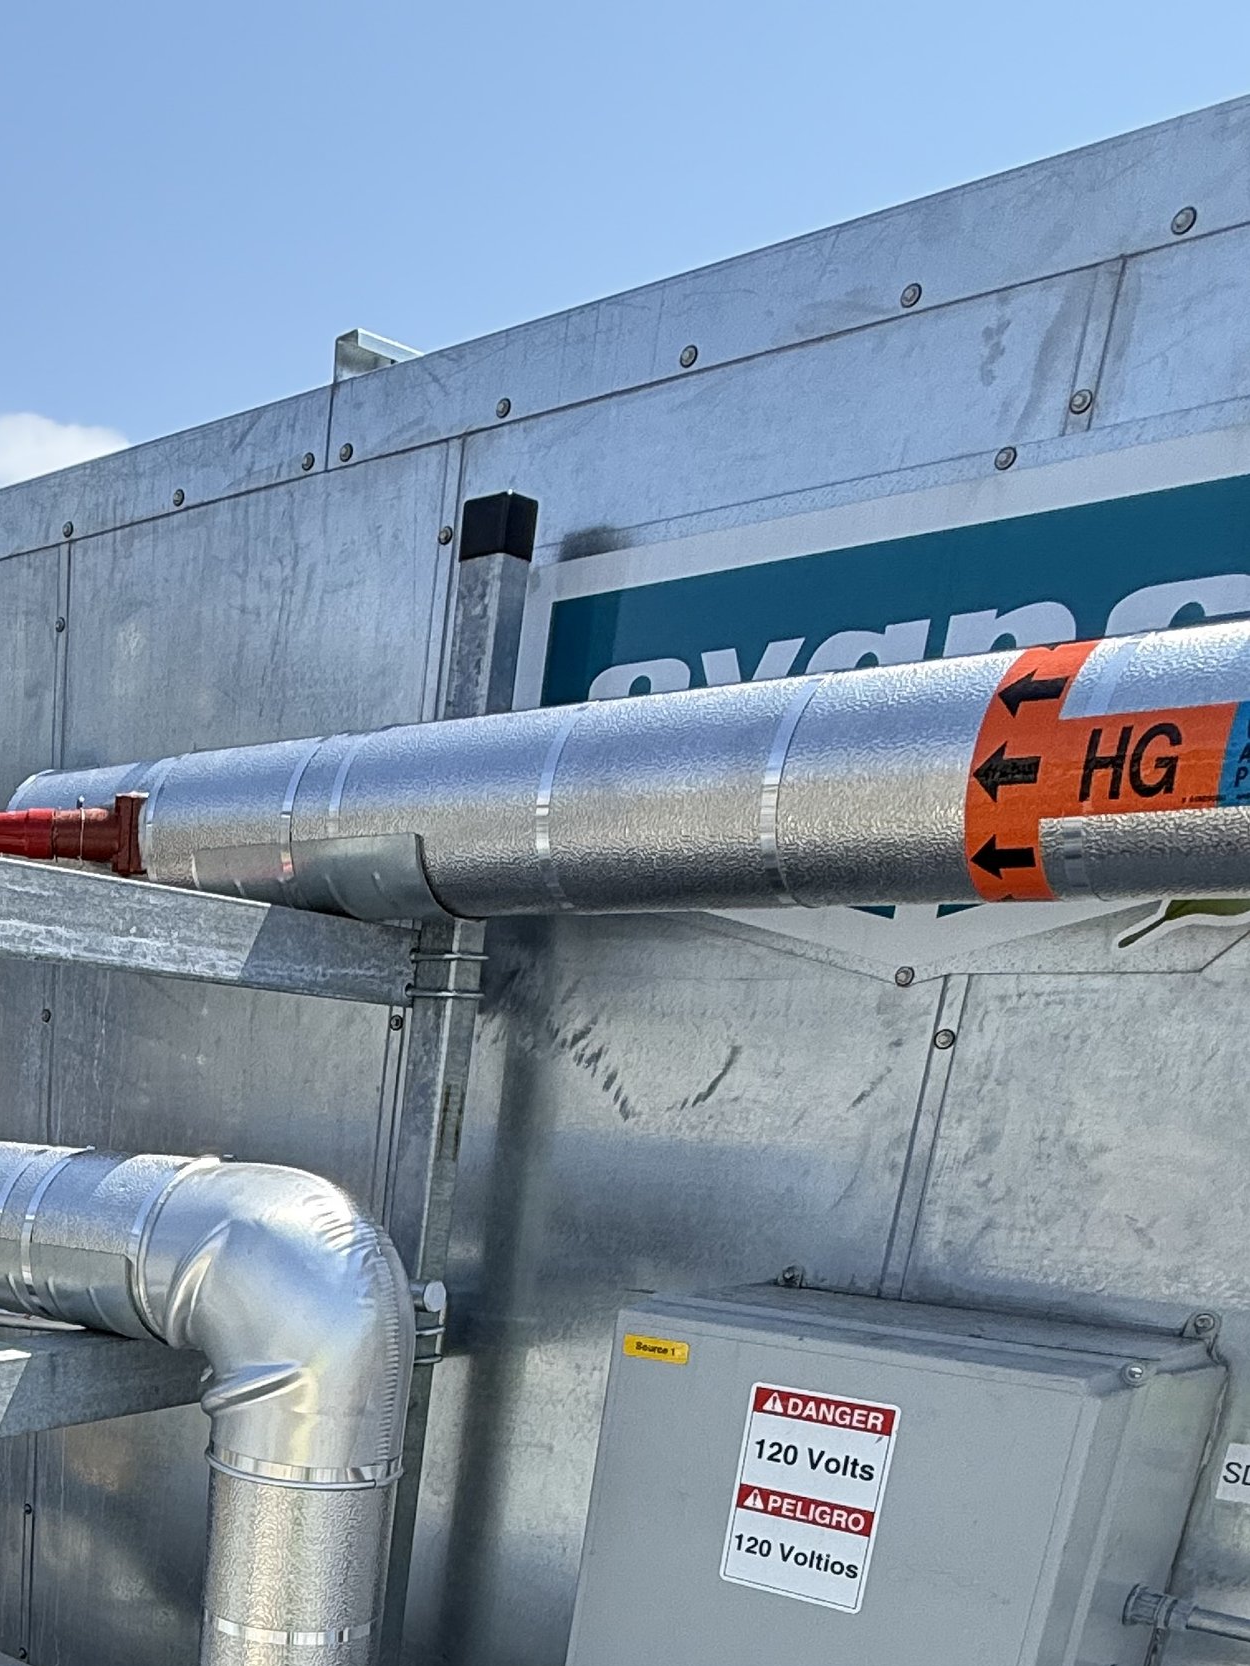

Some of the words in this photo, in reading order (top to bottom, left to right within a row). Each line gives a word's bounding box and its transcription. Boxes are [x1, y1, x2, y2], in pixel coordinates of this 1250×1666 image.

[1079, 722, 1183, 802] HG
[635, 1341, 668, 1355] Source
[670, 1347, 676, 1357] 1
[787, 1397, 885, 1431] DANGER
[754, 1438, 799, 1466] 120
[807, 1447, 875, 1482] Volts
[767, 1494, 865, 1532] PELIGRO
[734, 1533, 772, 1558] 120
[779, 1542, 859, 1580] Voltios
